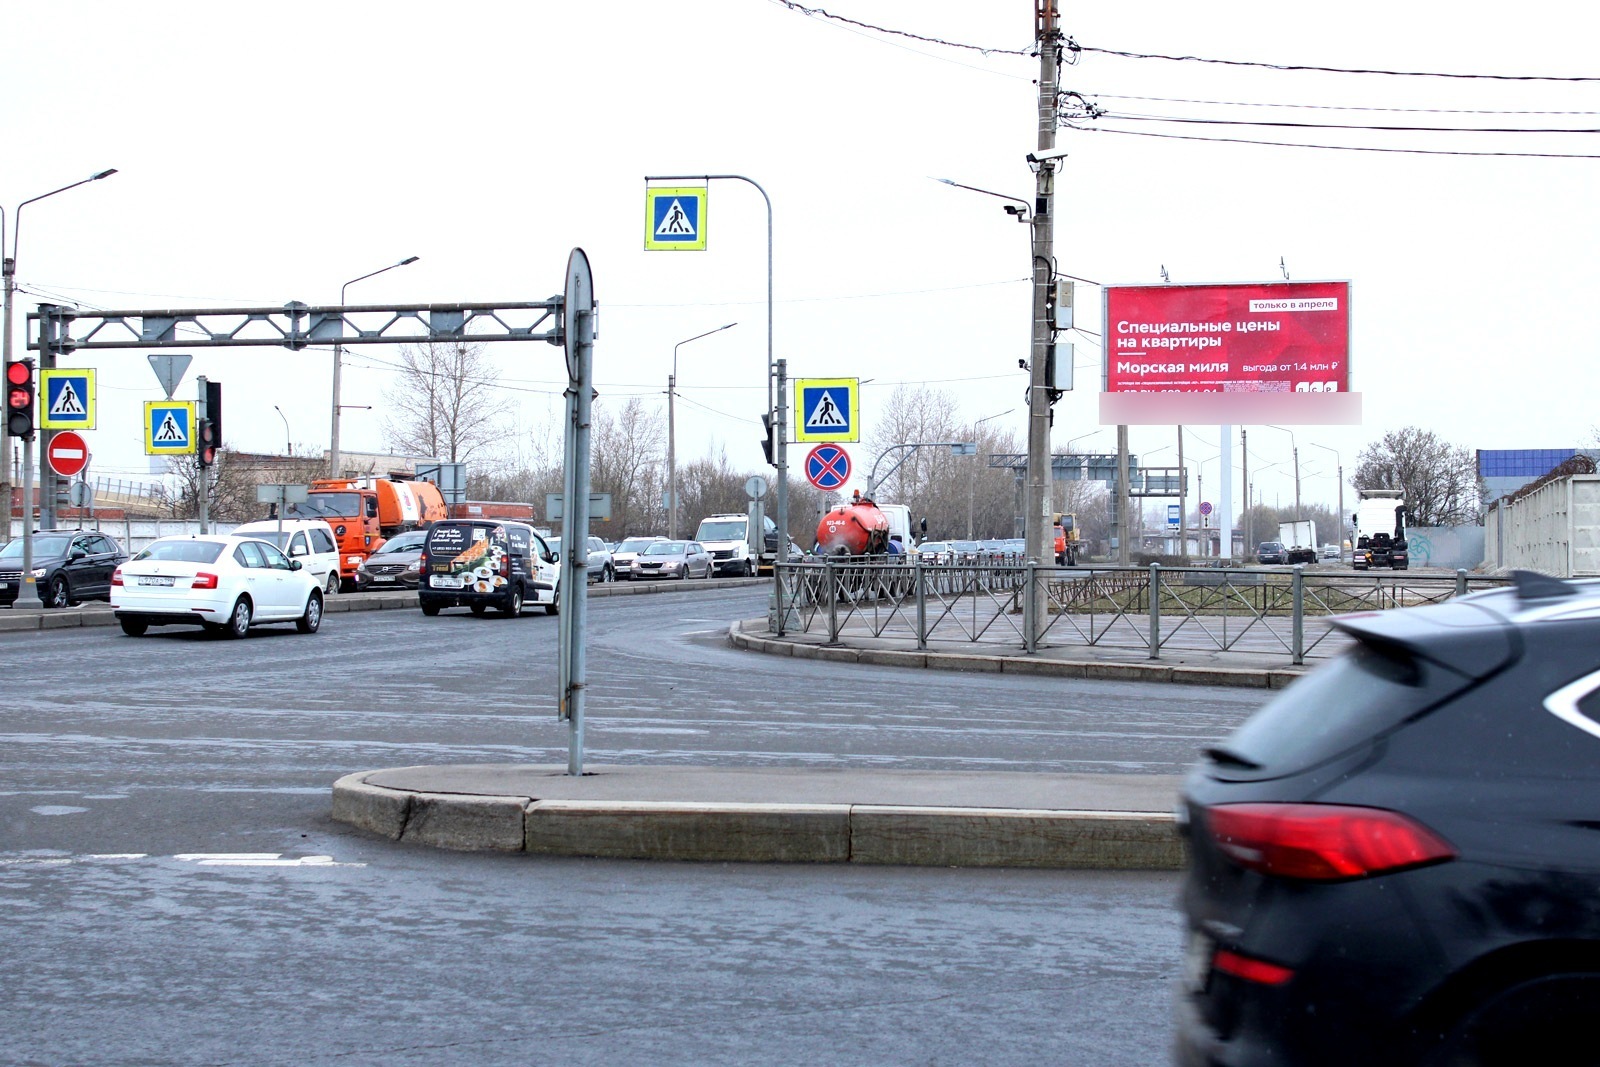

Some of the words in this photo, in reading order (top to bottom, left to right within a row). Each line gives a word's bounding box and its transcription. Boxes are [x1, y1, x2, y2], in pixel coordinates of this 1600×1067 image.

[1298, 301, 1334, 309] апреле
[1117, 320, 1232, 335] Специальные
[1236, 321, 1280, 333] цены
[1117, 338, 1137, 348] на
[1141, 337, 1222, 350] квартиры
[1117, 361, 1185, 376] Морская
[1189, 363, 1229, 373] миля
[1242, 364, 1278, 373] выгода
[10, 391, 29, 408] 24
